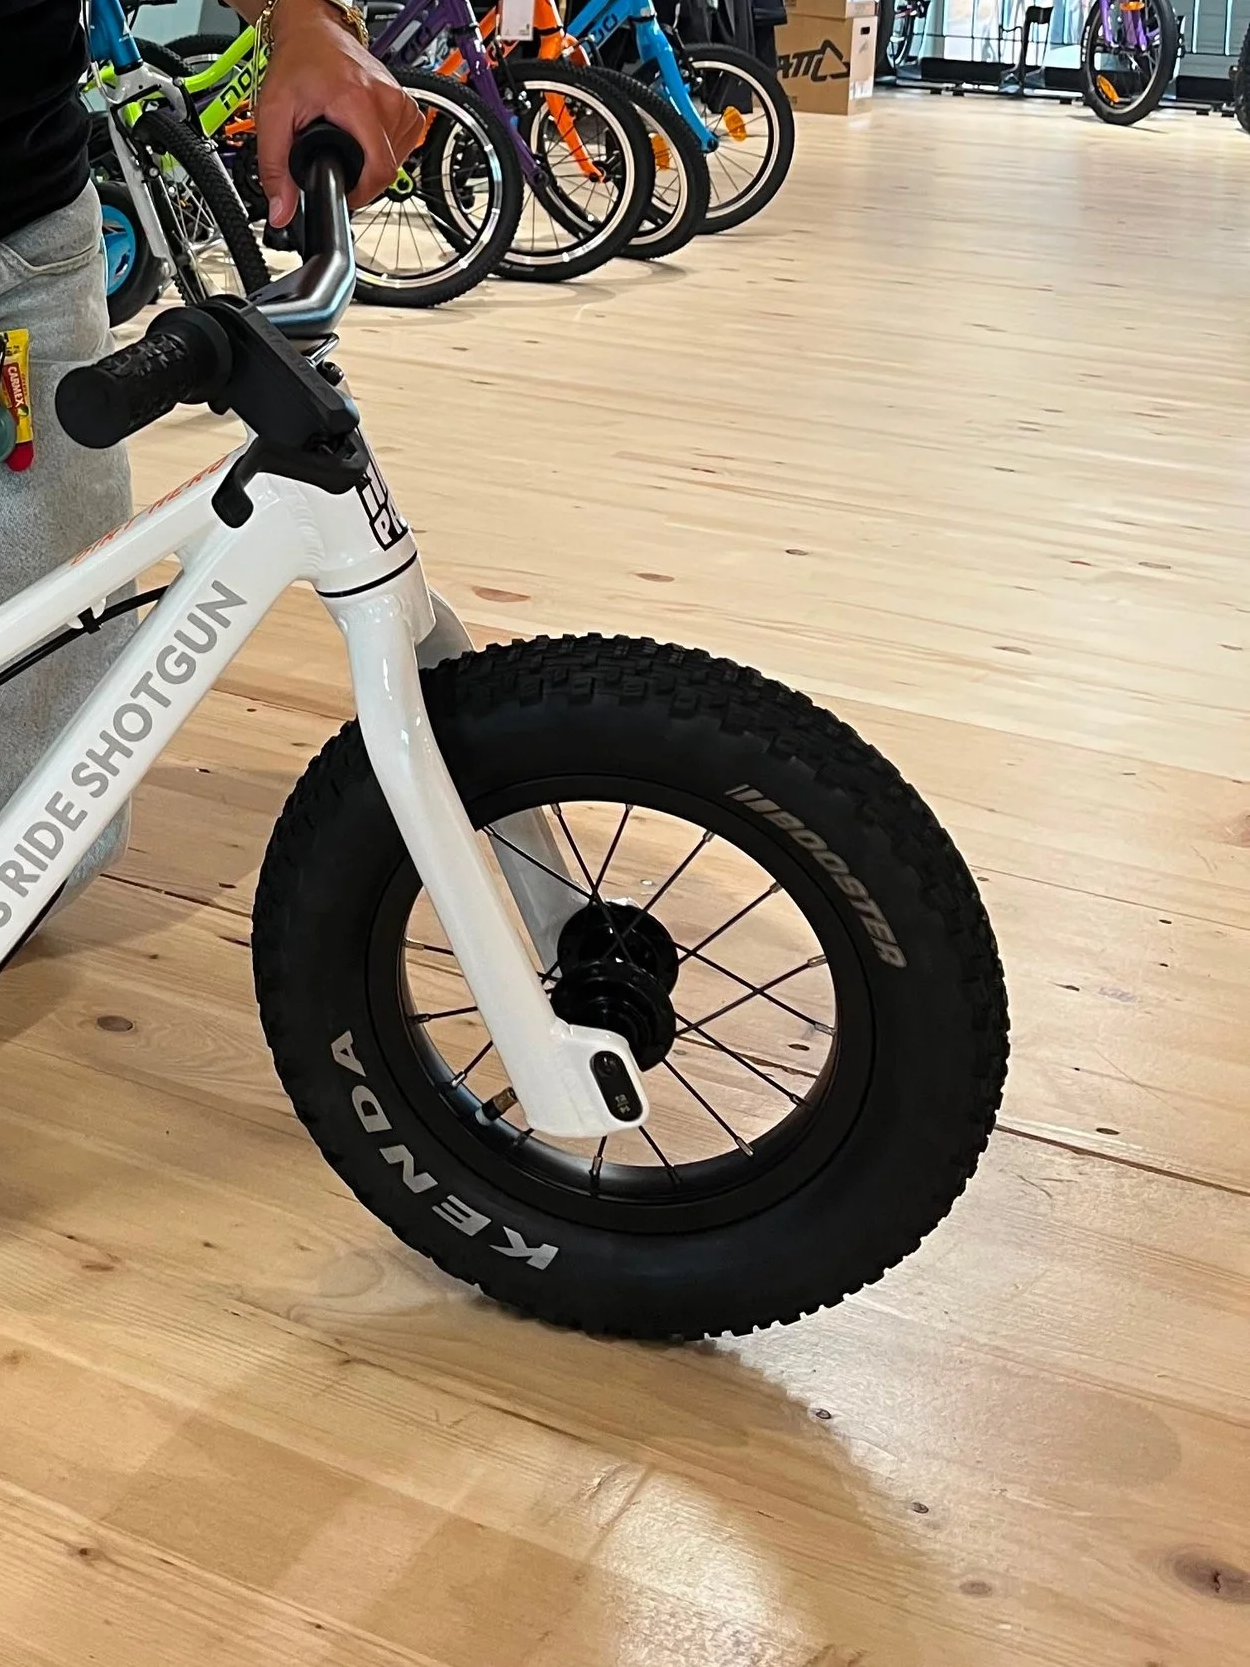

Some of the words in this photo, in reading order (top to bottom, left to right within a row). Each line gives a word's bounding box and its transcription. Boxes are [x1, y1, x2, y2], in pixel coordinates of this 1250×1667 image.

[7, 366, 25, 408] CARMEX
[71, 580, 248, 798] SHOTGUN
[763, 810, 907, 968] BOOSTER
[331, 1030, 559, 1270] KENDA
